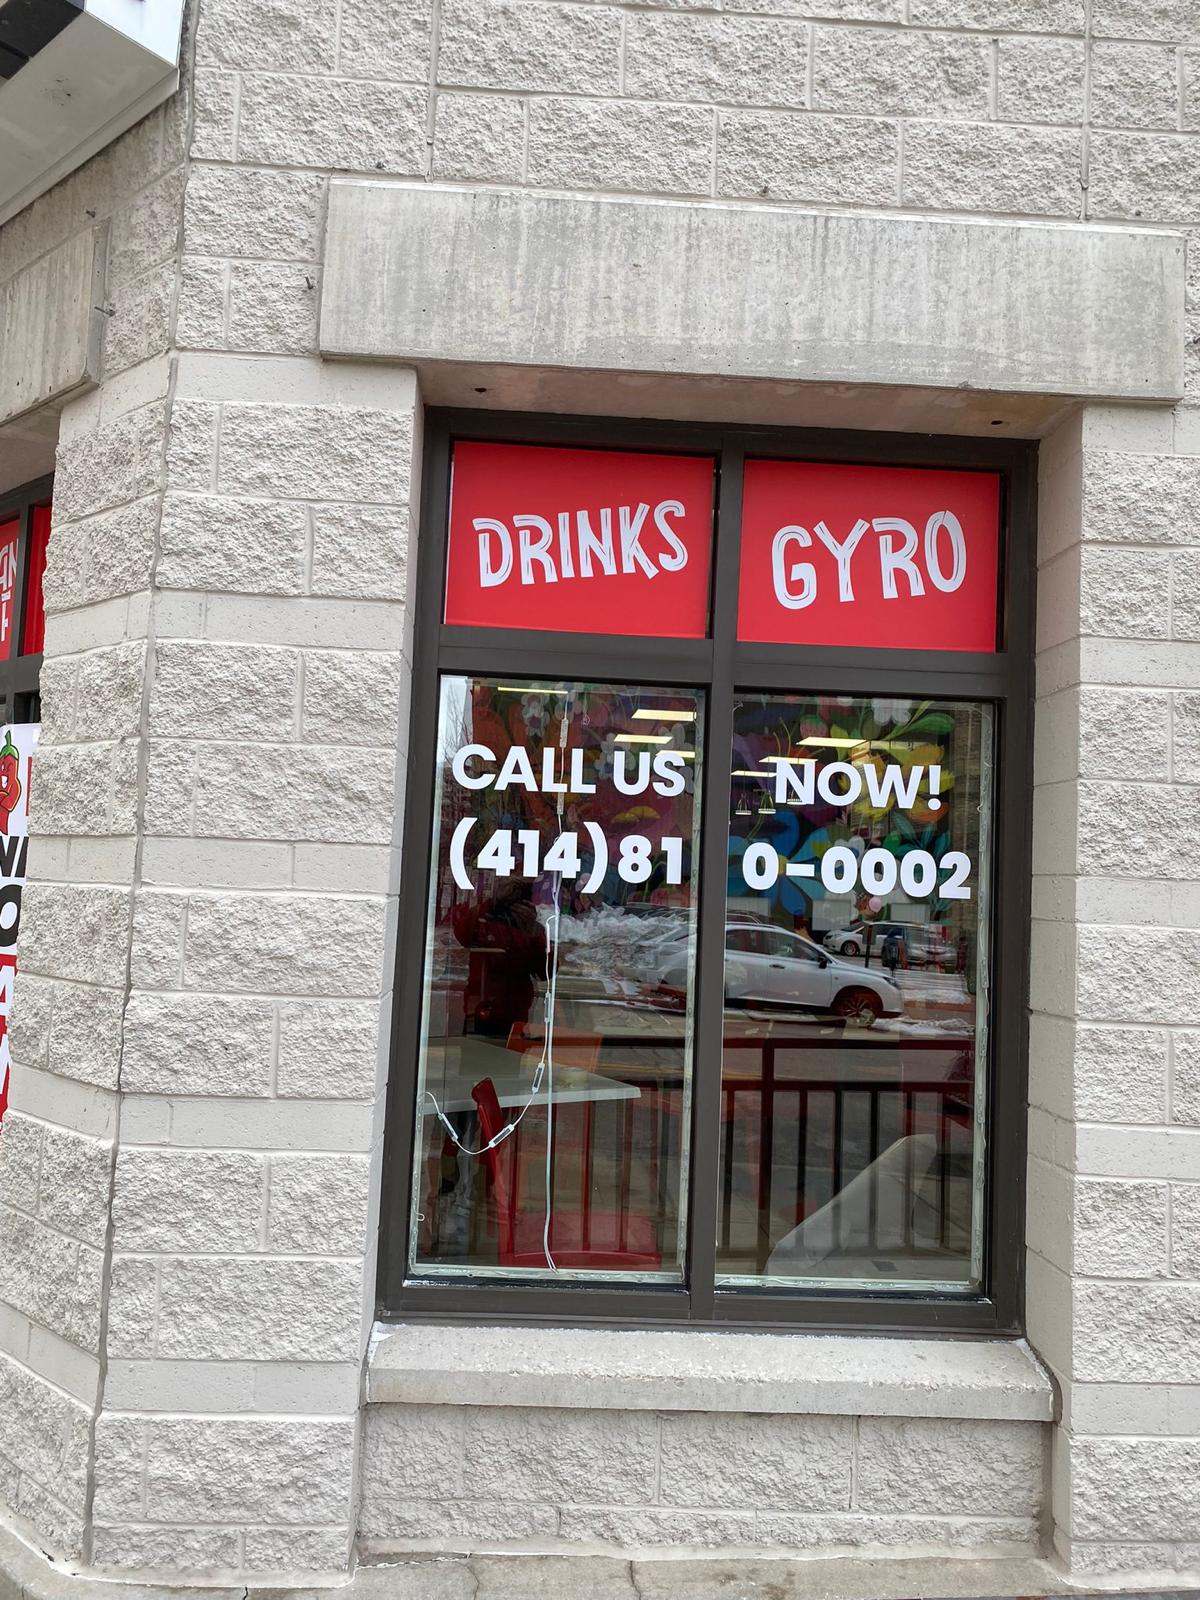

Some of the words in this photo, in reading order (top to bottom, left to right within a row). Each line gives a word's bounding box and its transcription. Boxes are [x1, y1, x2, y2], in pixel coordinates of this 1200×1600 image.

[473, 500, 688, 587] DRINKS
[772, 510, 967, 610] GYRO
[451, 745, 596, 793] CALL
[613, 752, 686, 797] US
[775, 761, 942, 811] NOW!
